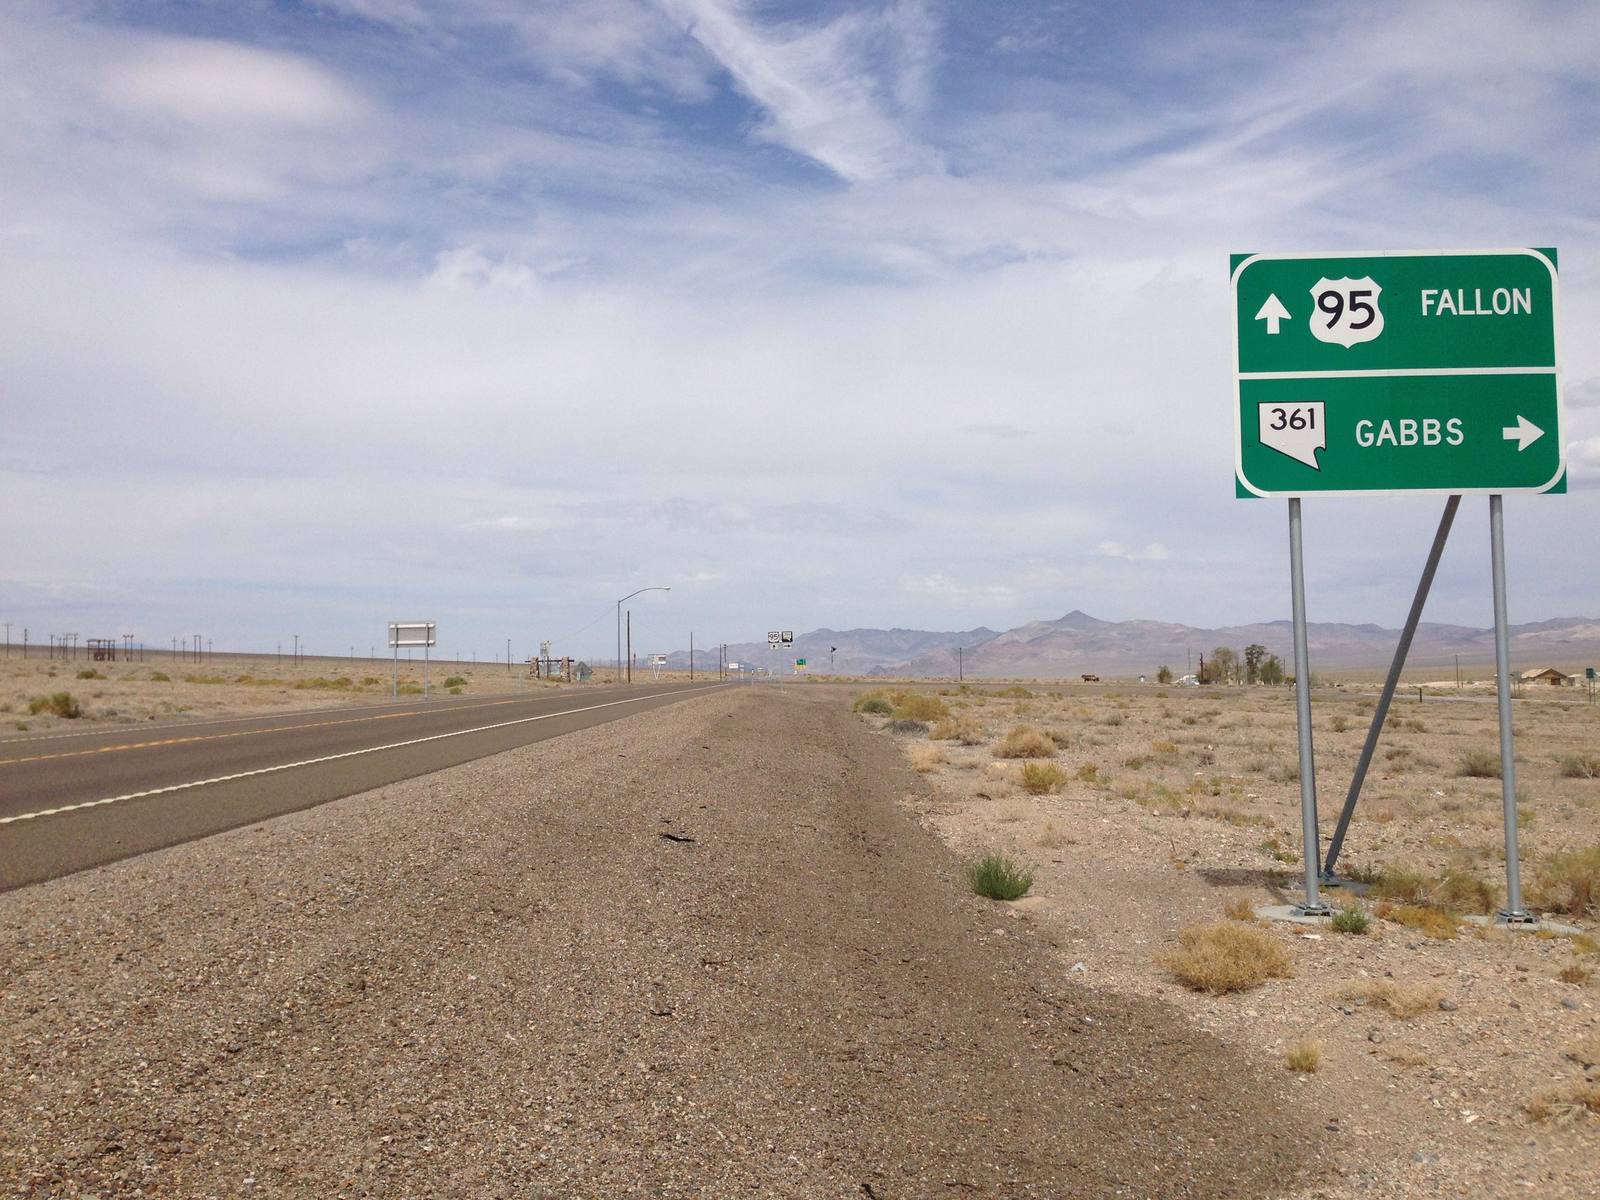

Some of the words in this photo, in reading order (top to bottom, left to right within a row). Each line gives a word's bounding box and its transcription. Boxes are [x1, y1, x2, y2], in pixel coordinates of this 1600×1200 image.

[1318, 290, 1375, 330] 95
[1421, 288, 1532, 316] FALLON
[1270, 408, 1315, 430] 361
[1356, 418, 1464, 447] GABBS
